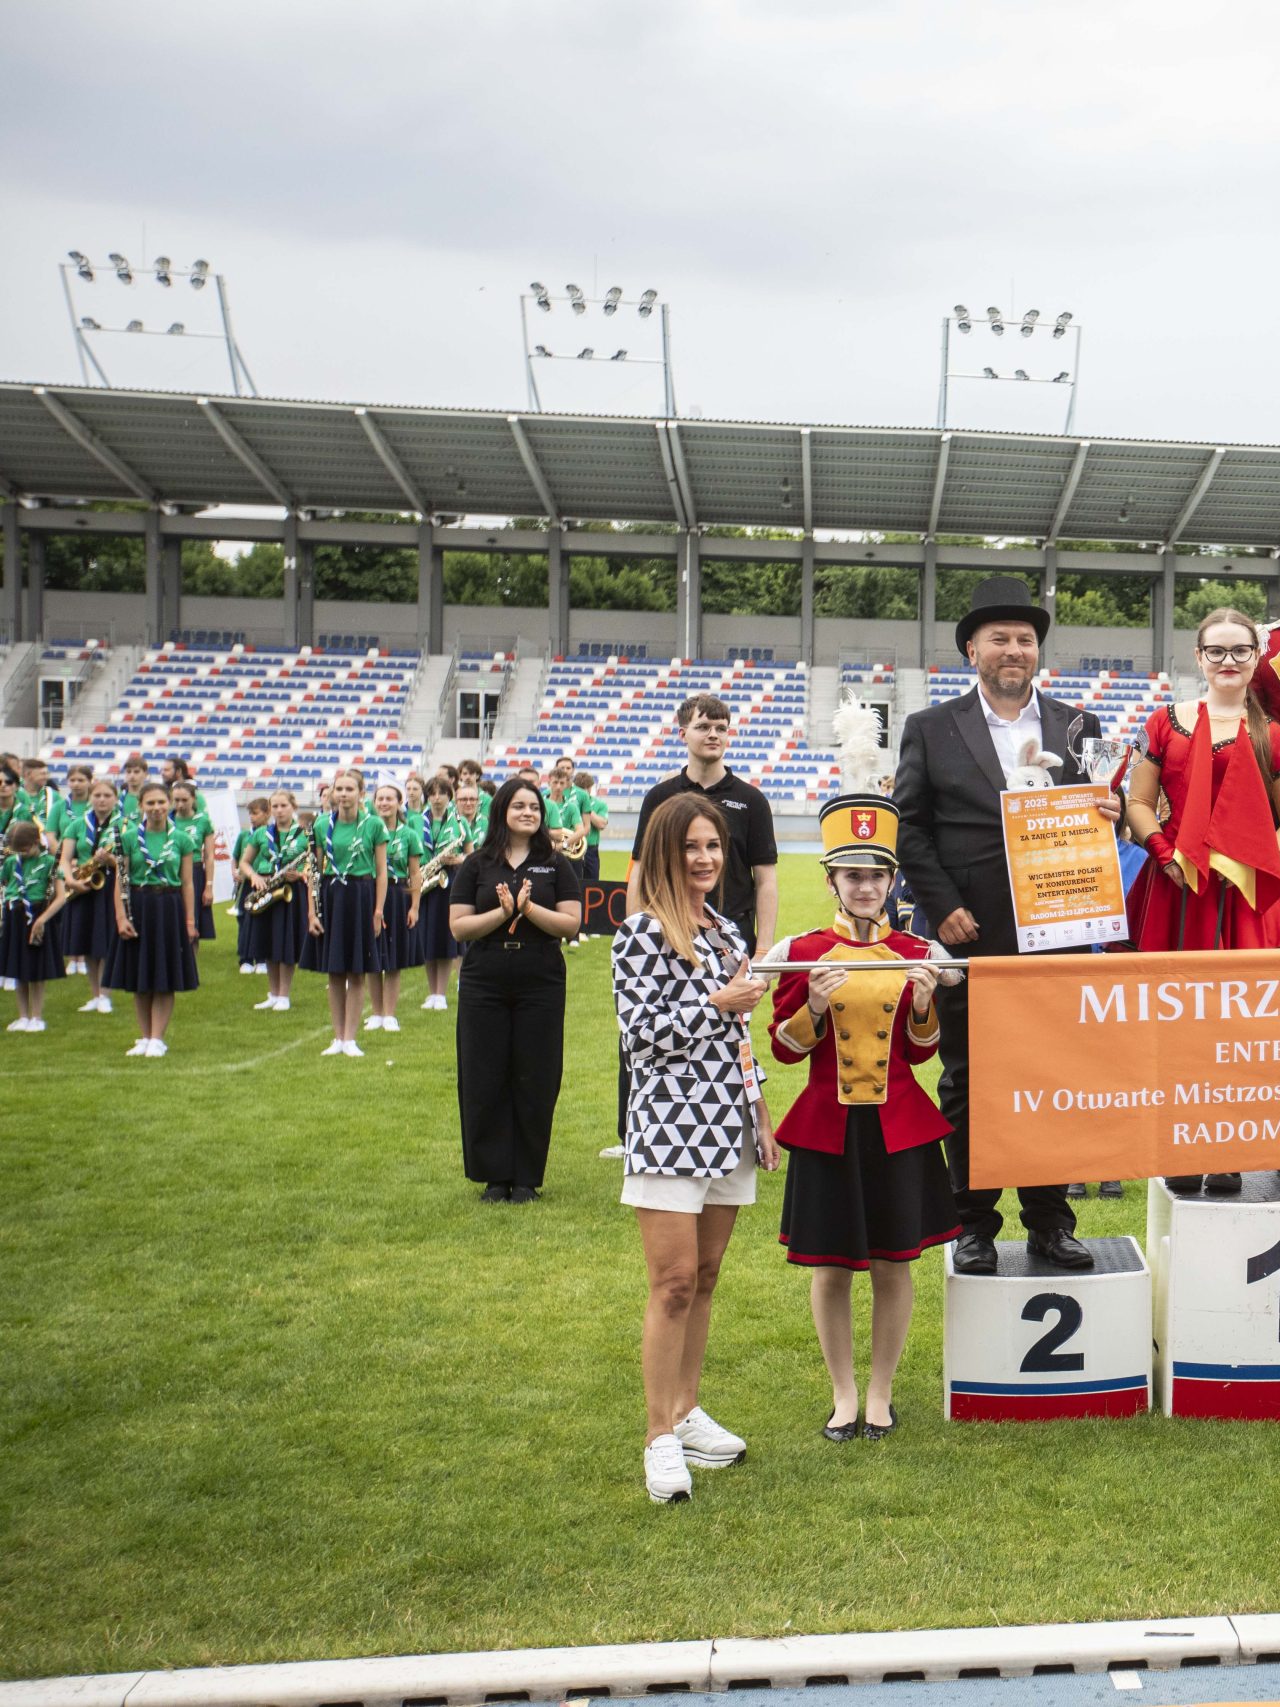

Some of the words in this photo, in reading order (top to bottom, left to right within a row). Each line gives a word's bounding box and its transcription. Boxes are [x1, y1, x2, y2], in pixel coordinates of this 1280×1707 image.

[283, 555, 296, 570] H
[1045, 585, 1056, 597] J
[1024, 798, 1048, 809] 2025
[1026, 813, 1089, 831] DYPLOM
[1028, 869, 1075, 881] WICEMISTRZ
[1077, 866, 1103, 875] POLSKI
[1045, 877, 1096, 888] KONKURENCJI
[1037, 885, 1099, 898] ENTERTAINMENT
[1030, 910, 1057, 920] RADOM
[1077, 980, 1280, 1024] MISTRZ
[1013, 1090, 1044, 1113] IV
[1052, 1085, 1165, 1111] Otwarte
[1019, 1292, 1085, 1373] 2
